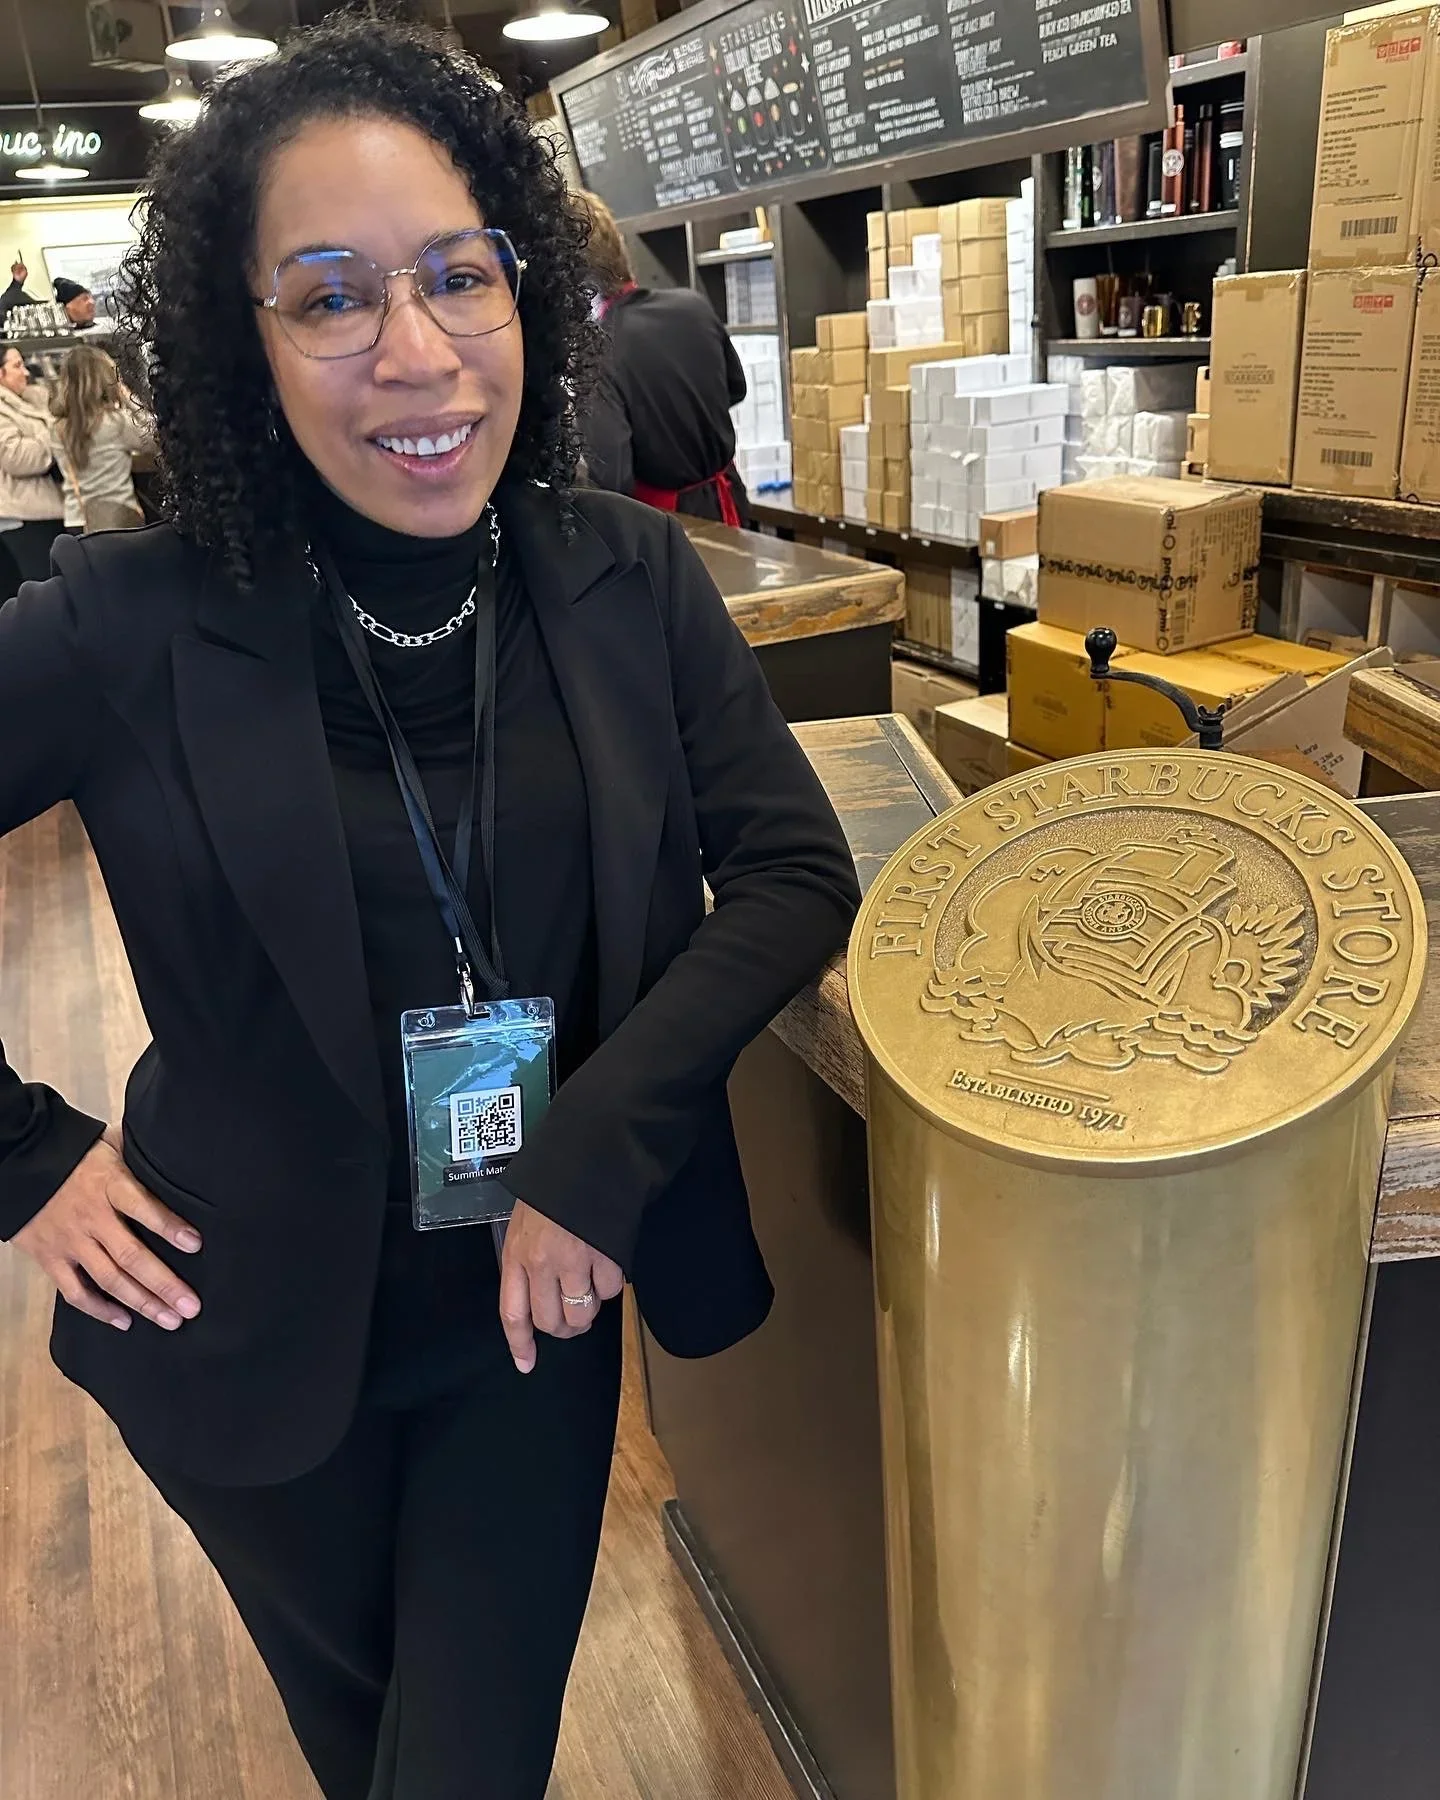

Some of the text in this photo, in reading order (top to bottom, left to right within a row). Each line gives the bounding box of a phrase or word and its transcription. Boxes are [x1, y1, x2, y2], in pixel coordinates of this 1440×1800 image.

[1100, 32, 1118, 48] TEA
[870, 762, 1402, 1050] FIRST STARBUCKS STORE
[1099, 893, 1143, 911] STARBUCKS
[1078, 1104, 1127, 1130] 1971
[448, 1170, 484, 1181] Summit
